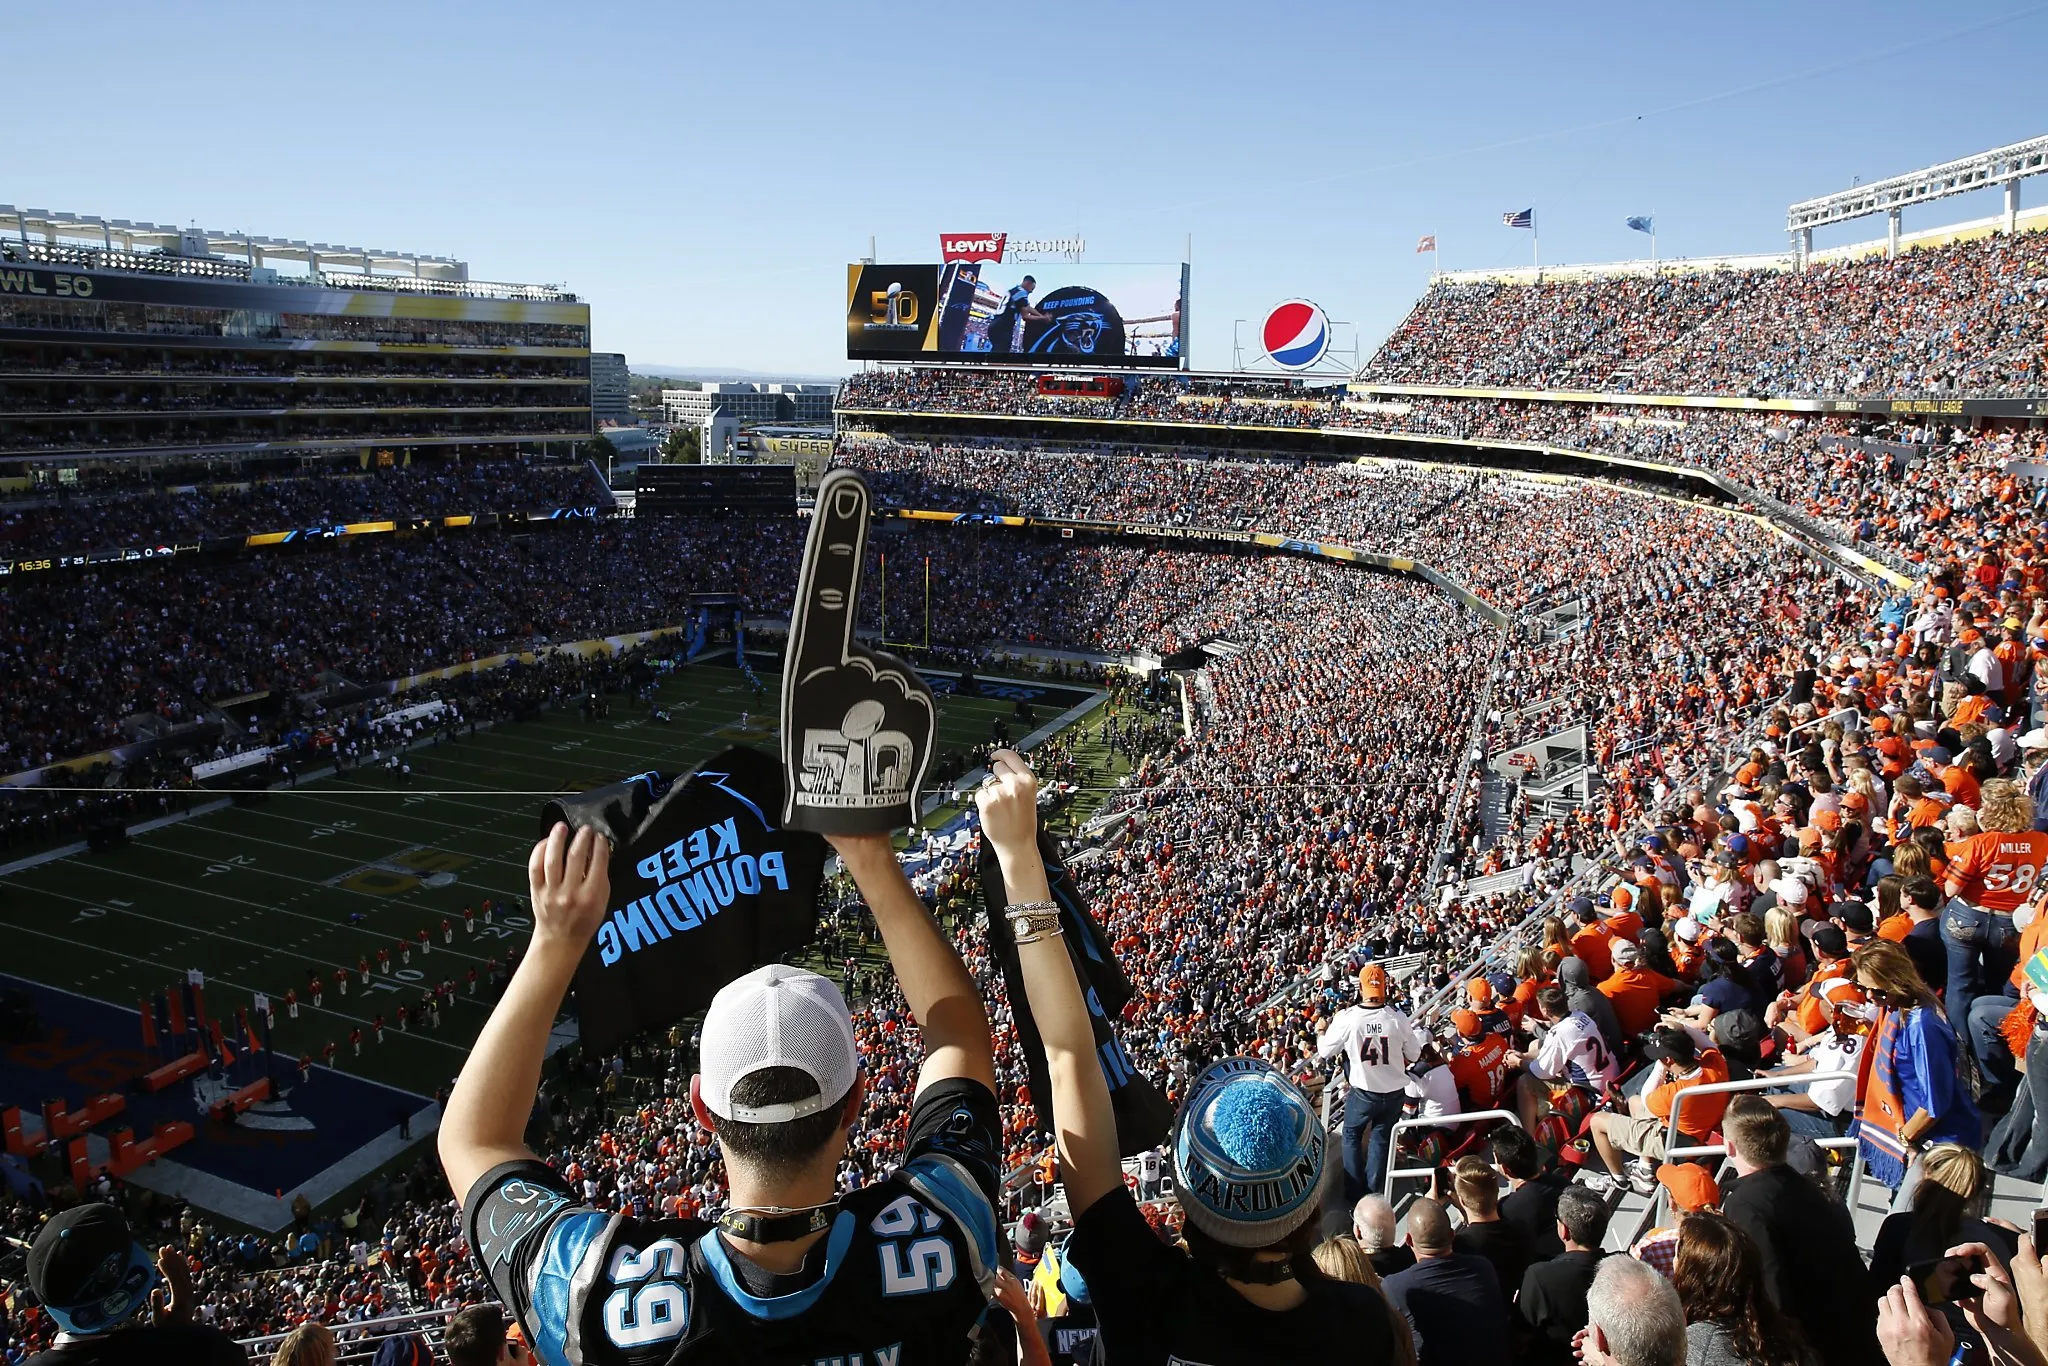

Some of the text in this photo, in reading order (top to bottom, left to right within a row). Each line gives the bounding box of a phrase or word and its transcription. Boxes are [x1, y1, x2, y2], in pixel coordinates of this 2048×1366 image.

[1007, 239, 1085, 253] STADIUM
[54, 273, 93, 297] 50
[870, 290, 919, 325] 50
[1043, 296, 1095, 310] KEEP POUNDING
[868, 323, 891, 331] SUPER
[1891, 400, 1964, 414] NATIONAL FOOTBALL LEAGUE
[780, 440, 829, 453] SUPER
[1125, 525, 1251, 543] CAROLINA PANTHERS
[18, 558, 50, 572] 16:36
[73, 556, 85, 565] 25
[799, 728, 914, 793] 50
[804, 795, 907, 806] SUPER BOWL
[2000, 842, 2032, 854] MILLER
[1983, 863, 2036, 894] 58
[1366, 1022, 1383, 1035] DMB
[1492, 1019, 1513, 1034] MILLER
[1360, 1036, 1390, 1067] 41
[1478, 1044, 1503, 1069] MANNING
[1486, 1064, 1505, 1096] 18
[1144, 1159, 1159, 1171] 18
[1183, 1135, 1323, 1213] CAROLINA
[732, 1219, 745, 1232] 50
[868, 1194, 959, 1299] 59
[603, 1237, 690, 1349] 59
